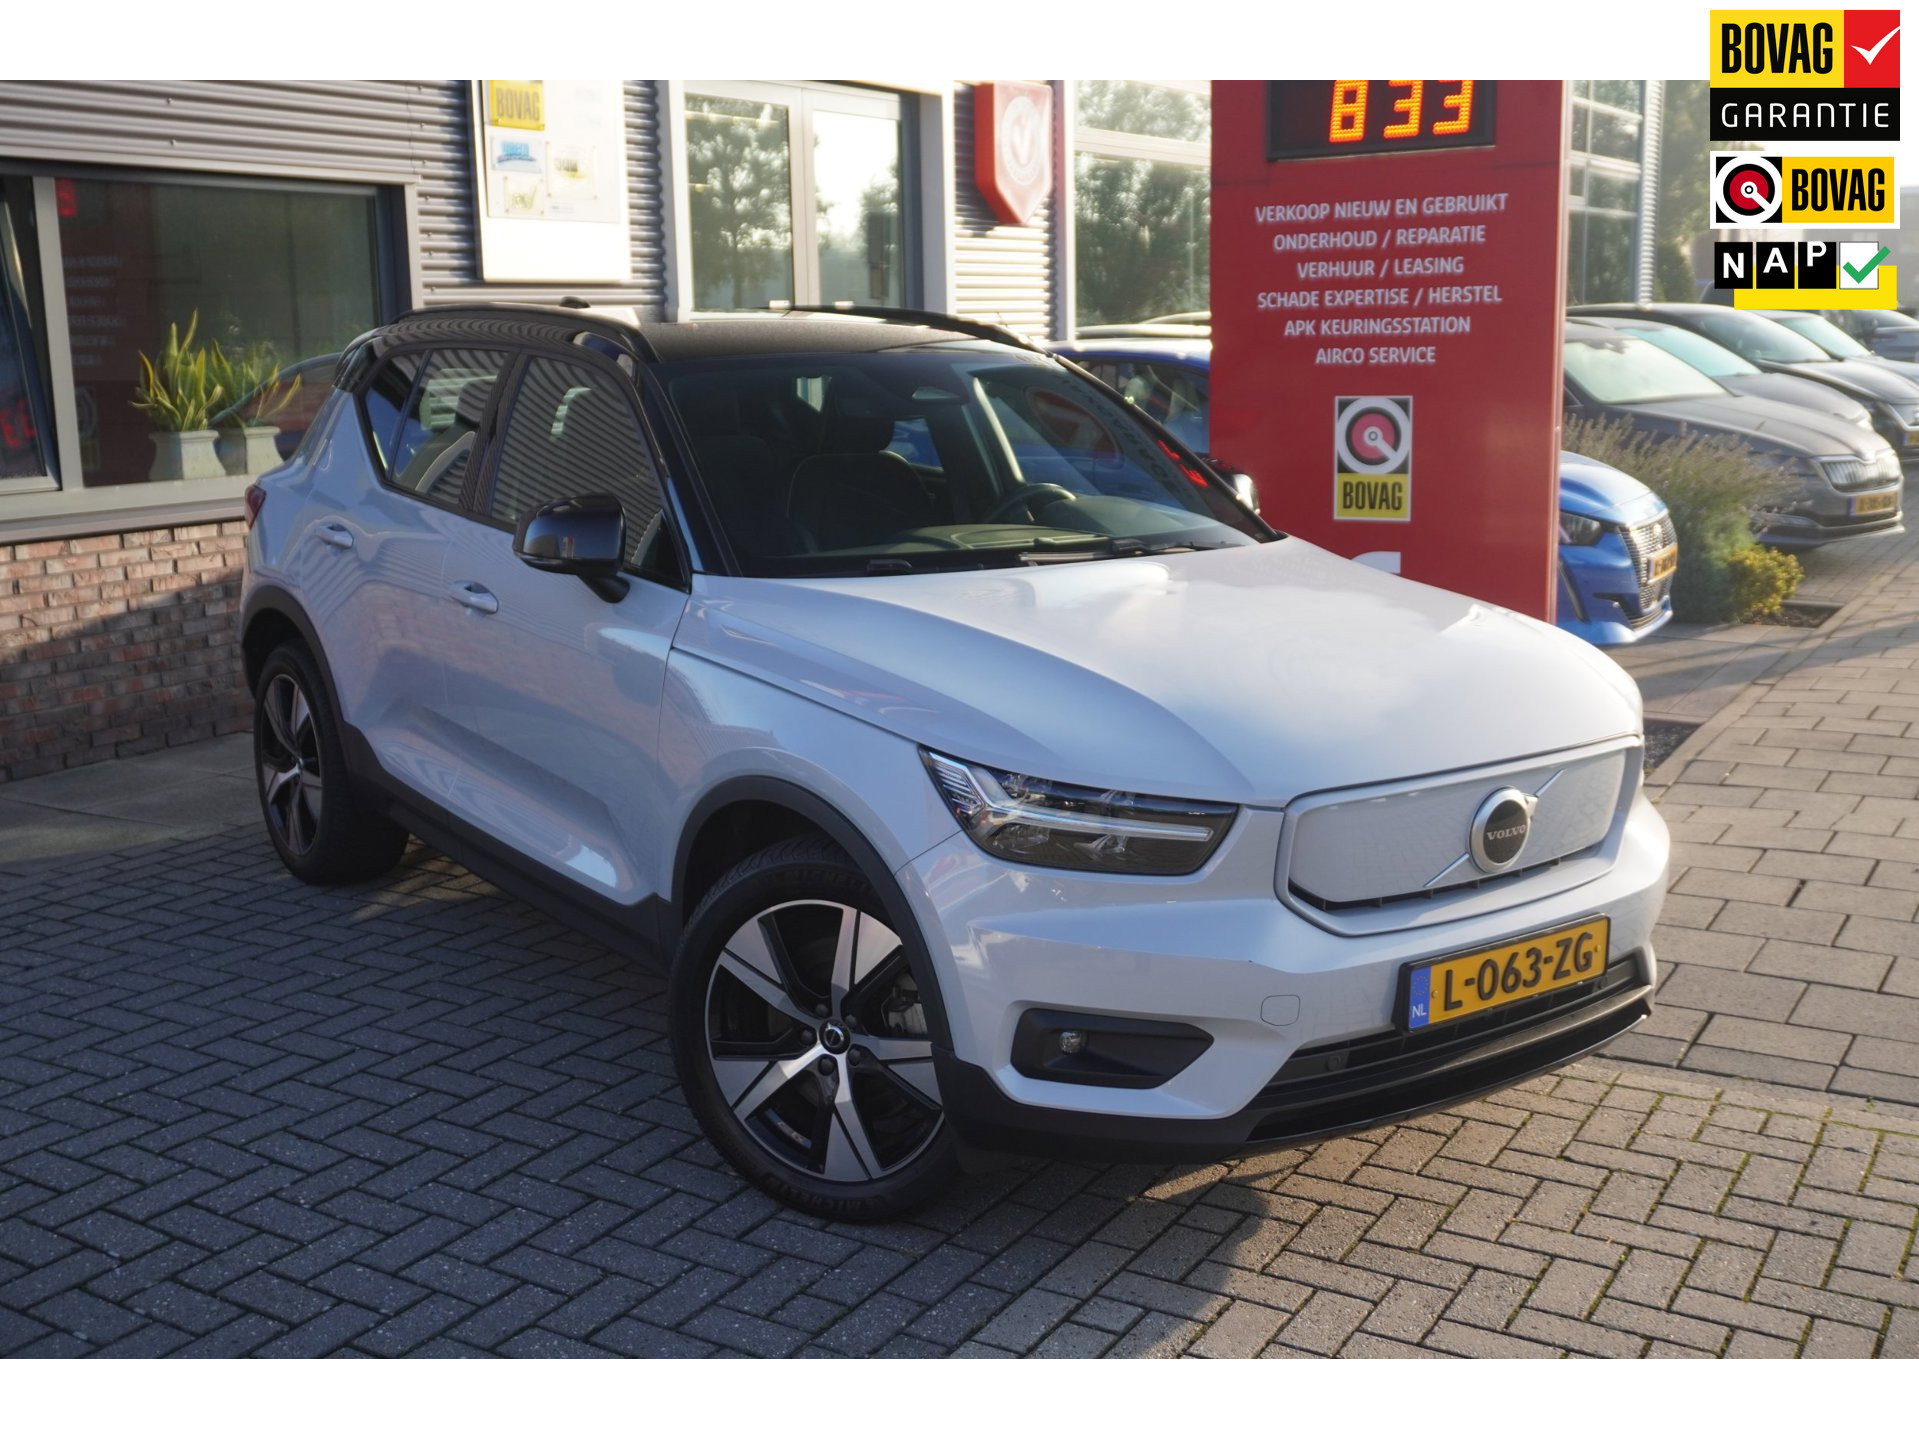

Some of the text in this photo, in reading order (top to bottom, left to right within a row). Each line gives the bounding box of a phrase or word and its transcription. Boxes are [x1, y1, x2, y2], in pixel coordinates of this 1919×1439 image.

[495, 87, 540, 121] BOVAG
[1255, 193, 1508, 223] VERKOOP NIEUW EN GEBRUIKT
[1273, 225, 1486, 250] ONDERHOUD / REPARATIE
[1297, 256, 1464, 279] VERHUUR / LEASING
[1258, 285, 1502, 309] SCHADE EXPERTISE / HERSTEL
[1284, 316, 1471, 336] APK KEURINGSSTATION
[1316, 346, 1436, 364] AIRCO SERVICE
[1343, 480, 1402, 510] BOVAG
[1486, 824, 1527, 841] VOLVO
[1444, 931, 1593, 1012] L-063-ZG
[1412, 1003, 1428, 1018] NL
